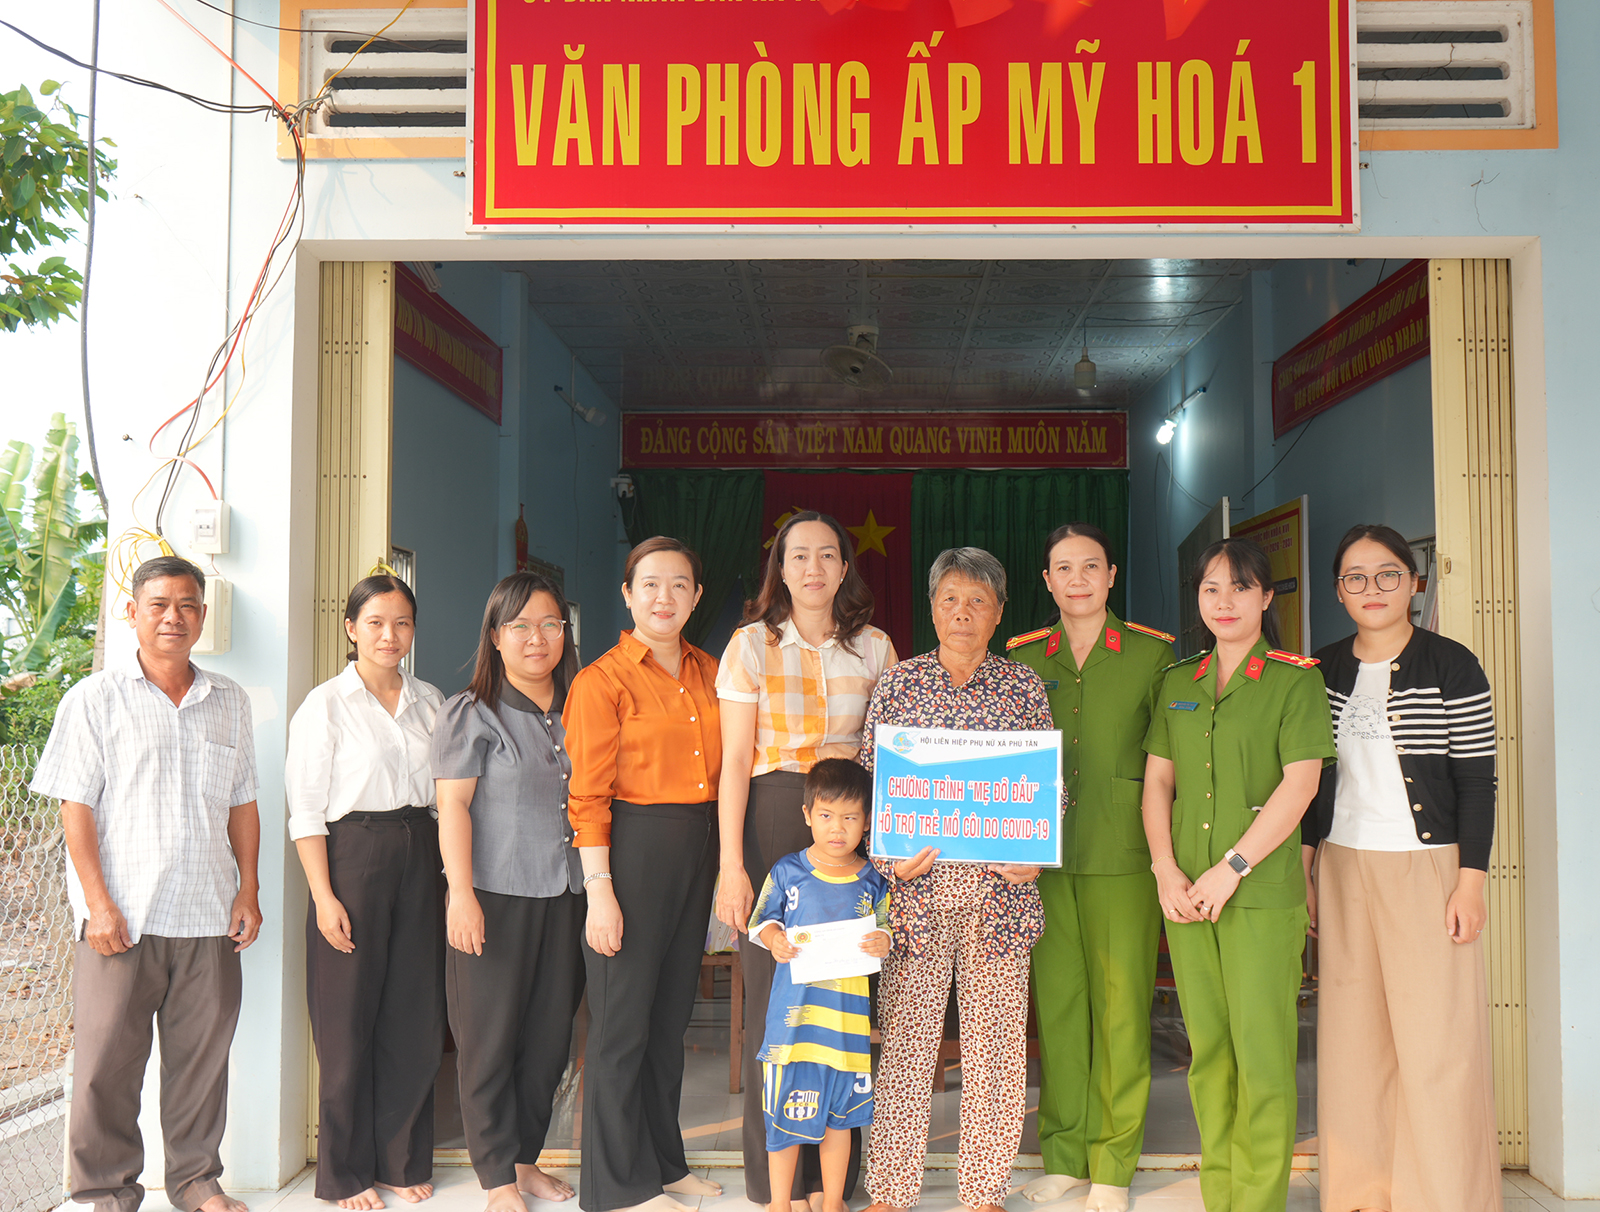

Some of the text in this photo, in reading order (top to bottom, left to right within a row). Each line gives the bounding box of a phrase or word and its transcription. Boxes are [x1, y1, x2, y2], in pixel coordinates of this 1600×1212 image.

[511, 31, 1317, 167] VĂN PHÒNG ẤP MỸ HOÁ 1
[1326, 366, 1339, 393] HỘI
[1352, 349, 1367, 378] HỘI
[1368, 336, 1394, 368] ĐỒNG
[1395, 319, 1423, 353] NHÂN
[640, 419, 1107, 460] ĐẢNG CỘNG SẢN VIỆT NAM QUANG VINH MUÔN NĂM
[920, 736, 932, 745] HỘI
[934, 737, 949, 745] LIÊN
[952, 737, 967, 747] HIỆP
[970, 739, 983, 747] PHỤ
[1025, 739, 1038, 747] TÂN
[889, 776, 929, 798] CHƯƠNG
[933, 776, 964, 799] TRÌNH
[994, 778, 1007, 801] ĐỠ
[878, 804, 1049, 839] HỖ TRỢ TRẺ MỒ CÔI DO COVID-19
